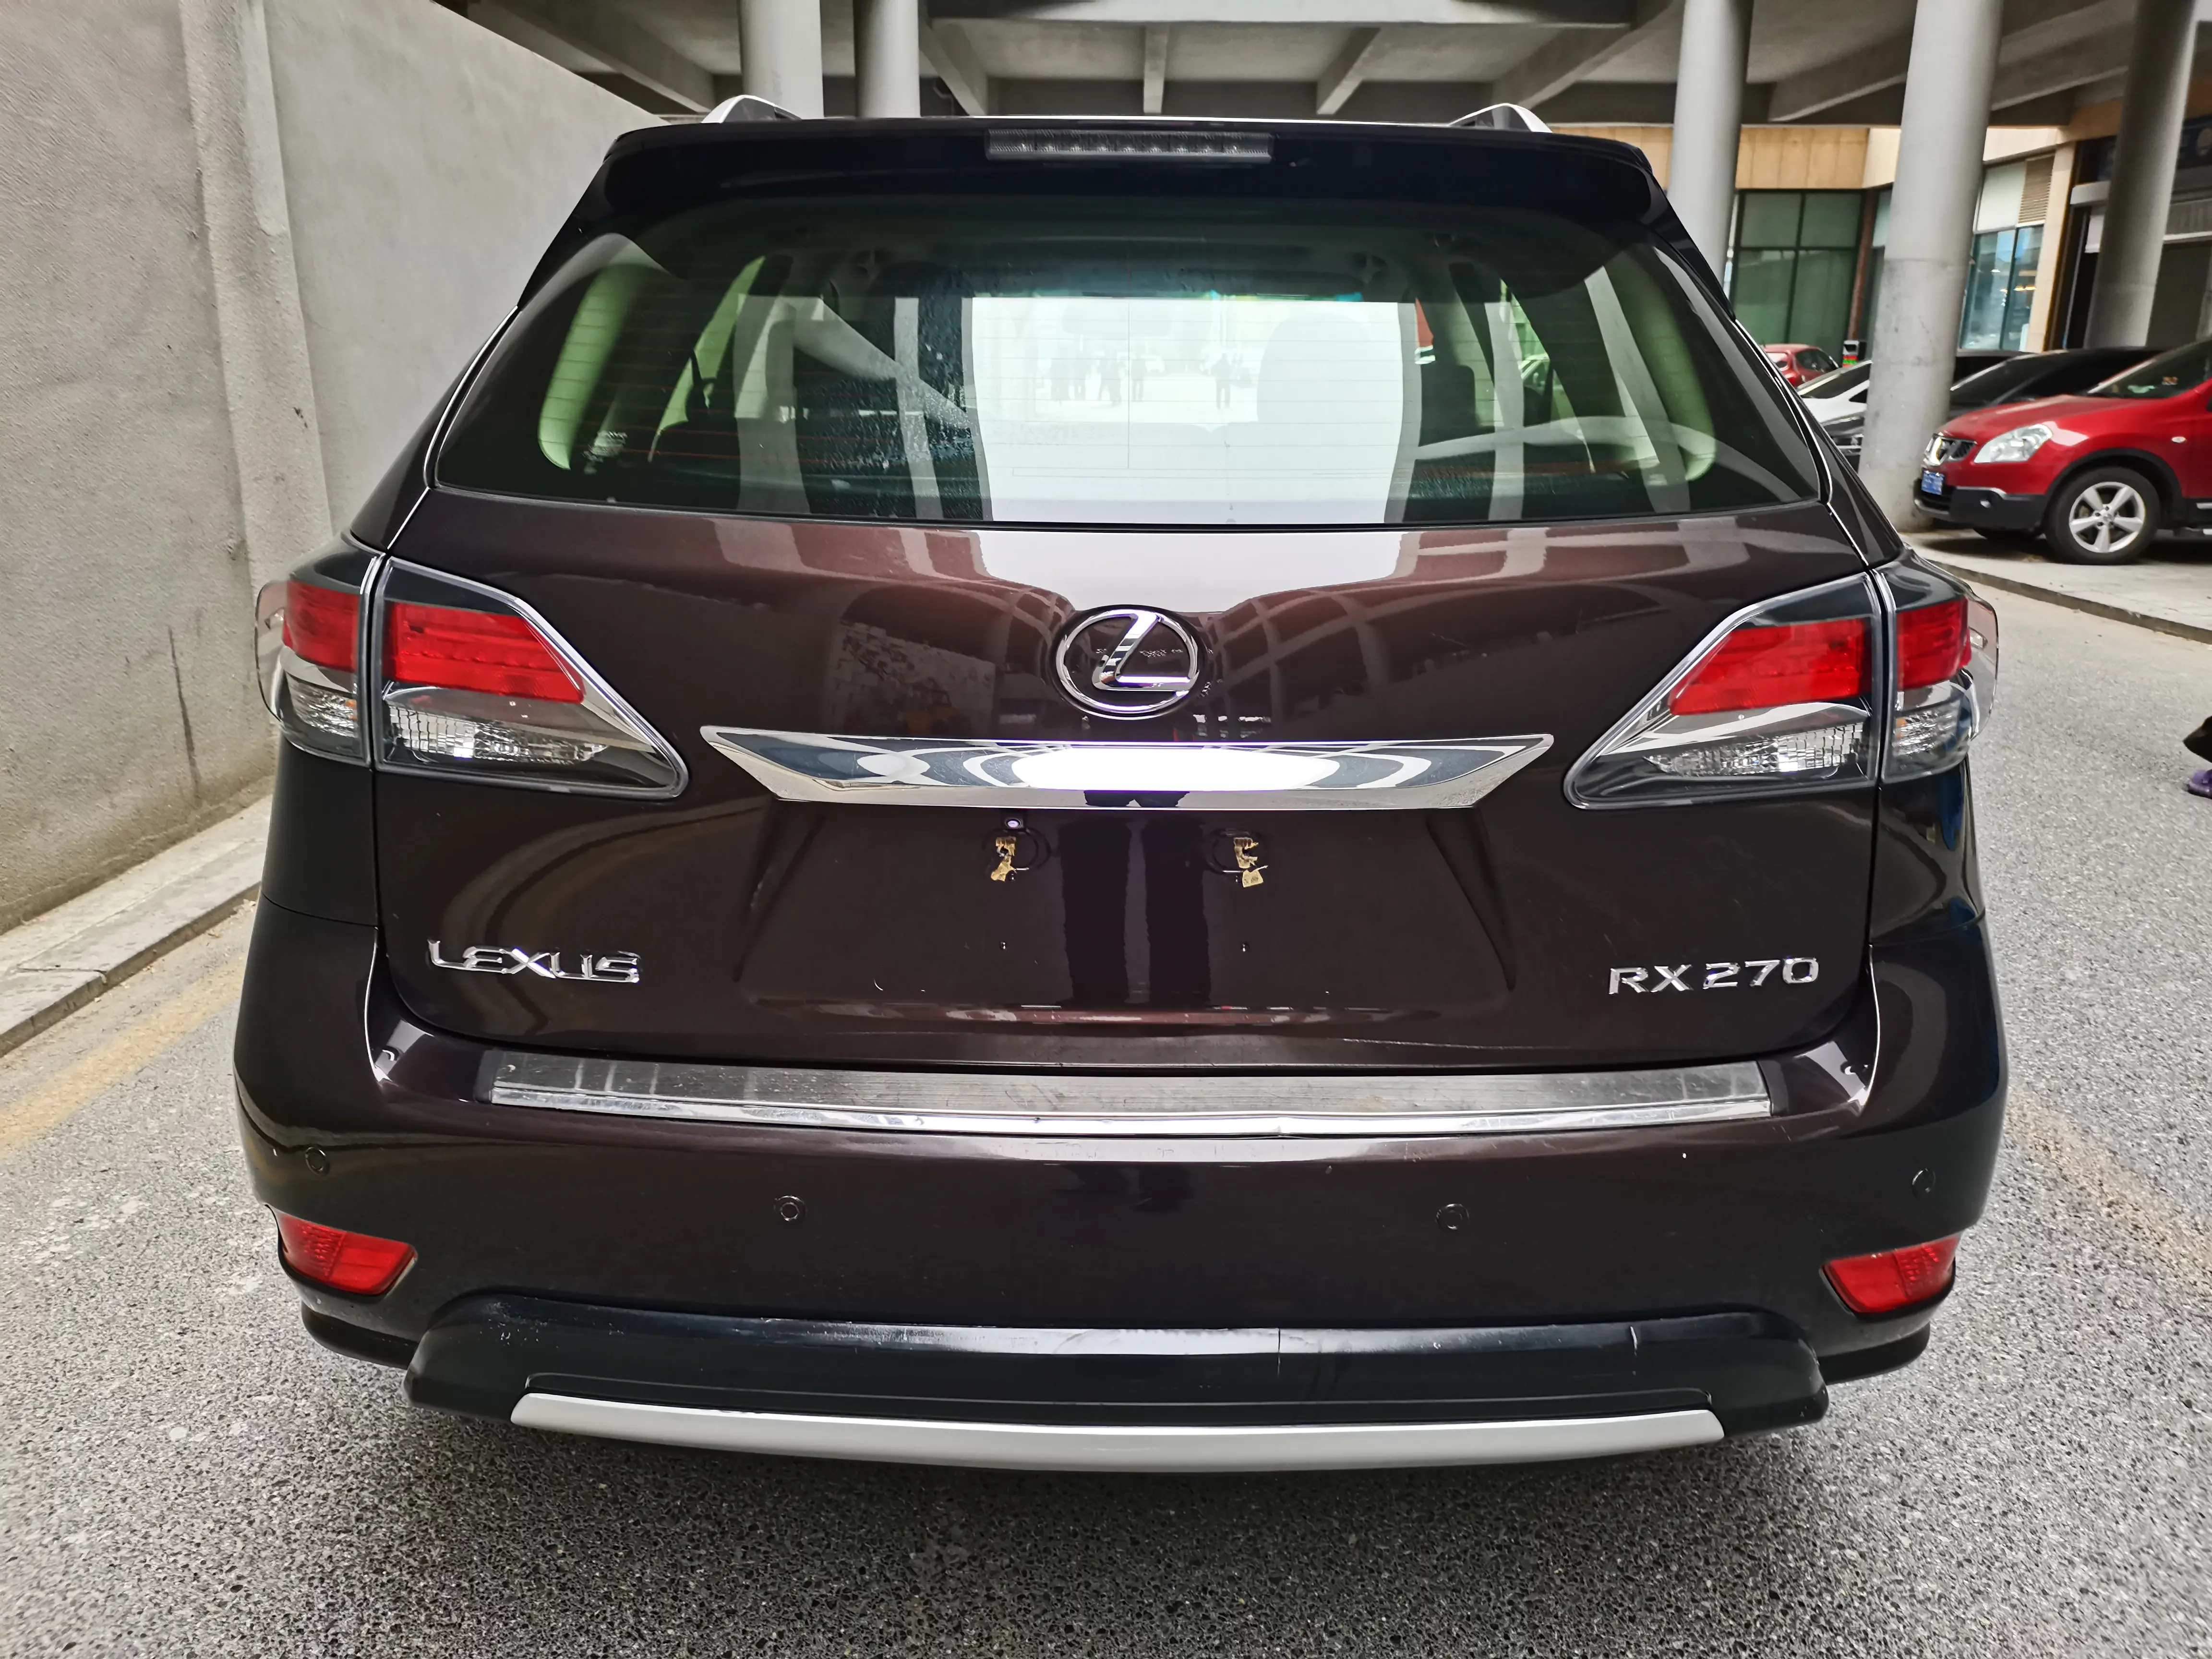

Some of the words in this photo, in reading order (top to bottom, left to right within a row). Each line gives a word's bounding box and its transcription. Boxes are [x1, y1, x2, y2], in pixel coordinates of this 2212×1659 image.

[426, 938, 641, 983] LEXUS
[1608, 964, 1694, 995] RX
[1702, 957, 1819, 990] 270
